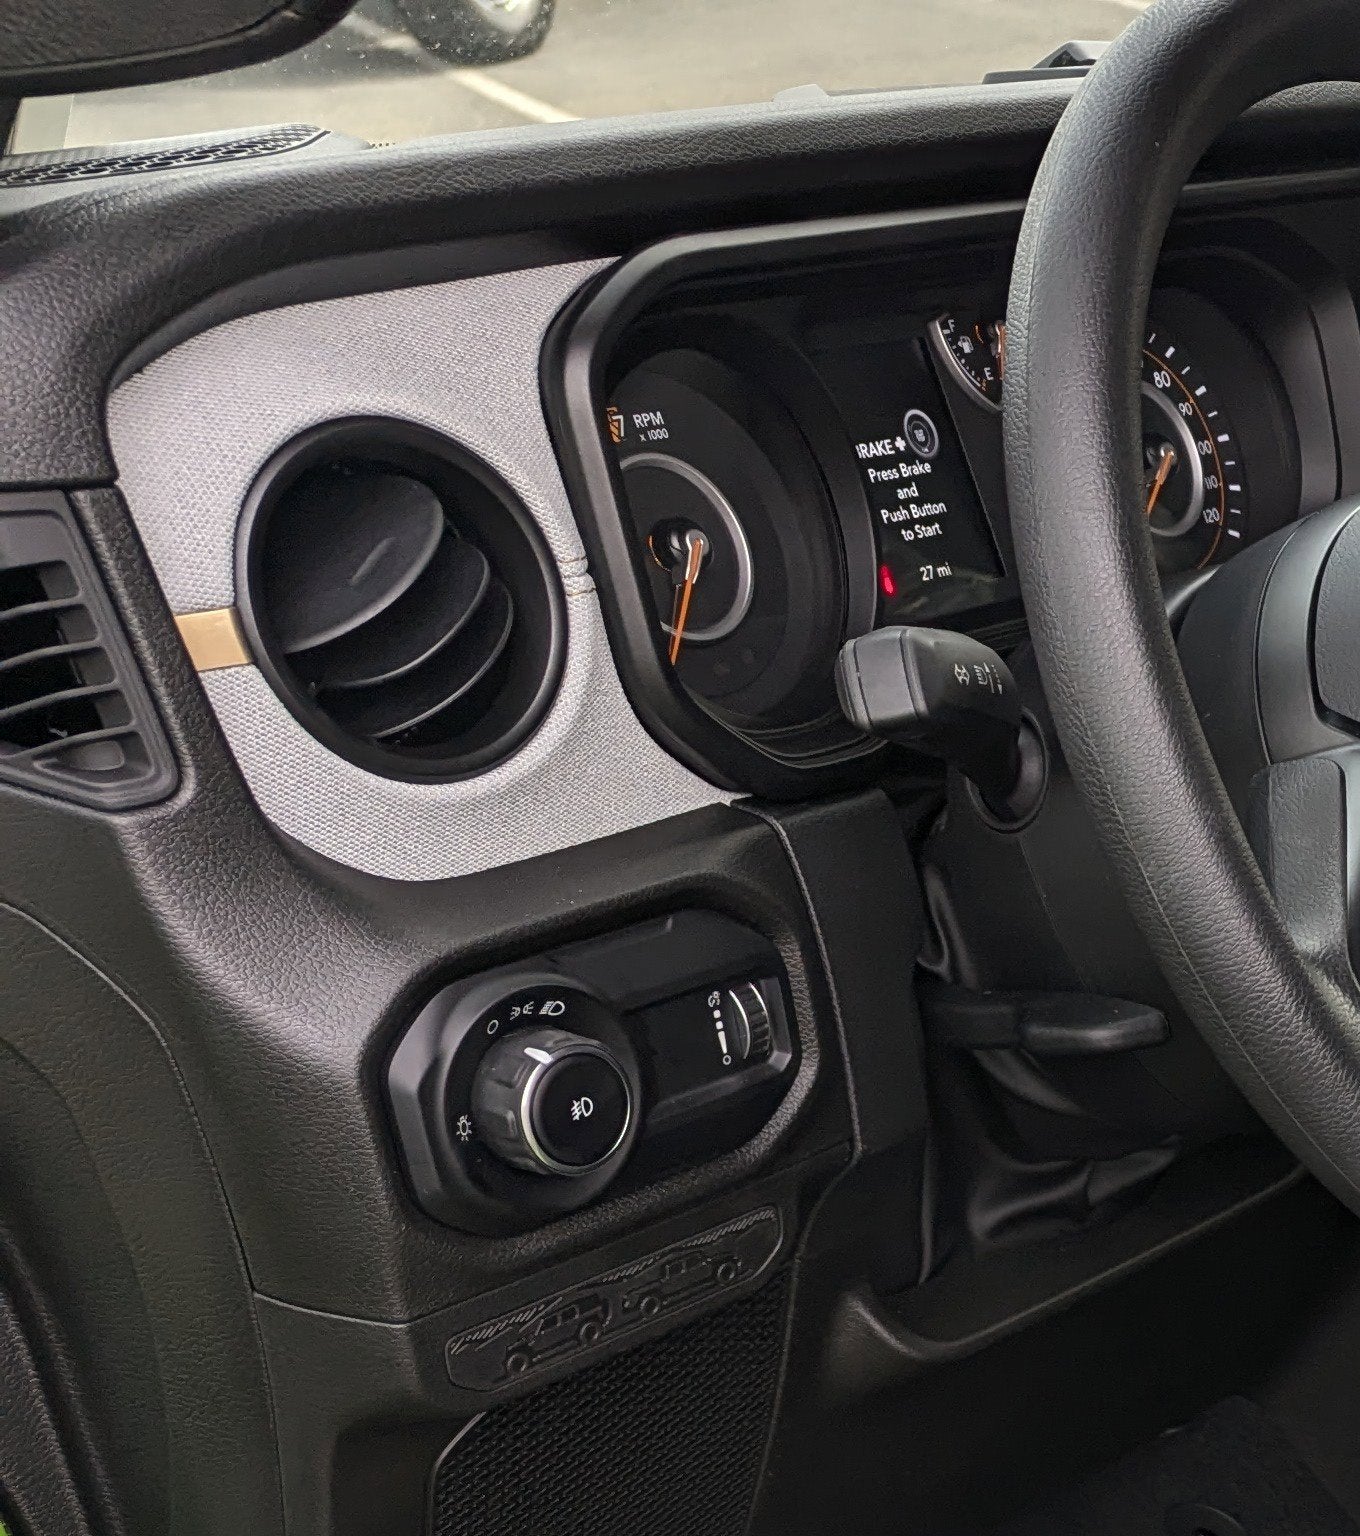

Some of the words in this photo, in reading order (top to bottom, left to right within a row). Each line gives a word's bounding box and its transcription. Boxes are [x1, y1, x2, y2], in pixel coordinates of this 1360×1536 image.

[948, 319, 955, 332] F
[984, 367, 994, 381] E
[1153, 370, 1171, 388] 80
[1178, 402, 1193, 416] 90
[632, 411, 665, 428] RPM
[647, 427, 669, 440] 1000
[1197, 440, 1212, 455] 00
[867, 464, 900, 483] Press
[899, 460, 932, 478] Brake
[1204, 475, 1219, 489] 110
[896, 482, 919, 500] and
[880, 507, 910, 524] Push
[909, 501, 947, 519] Button
[1203, 507, 1220, 524] 120
[901, 528, 915, 541] to
[914, 523, 943, 539] Start
[919, 565, 935, 581] 27
[936, 561, 952, 577] mi
